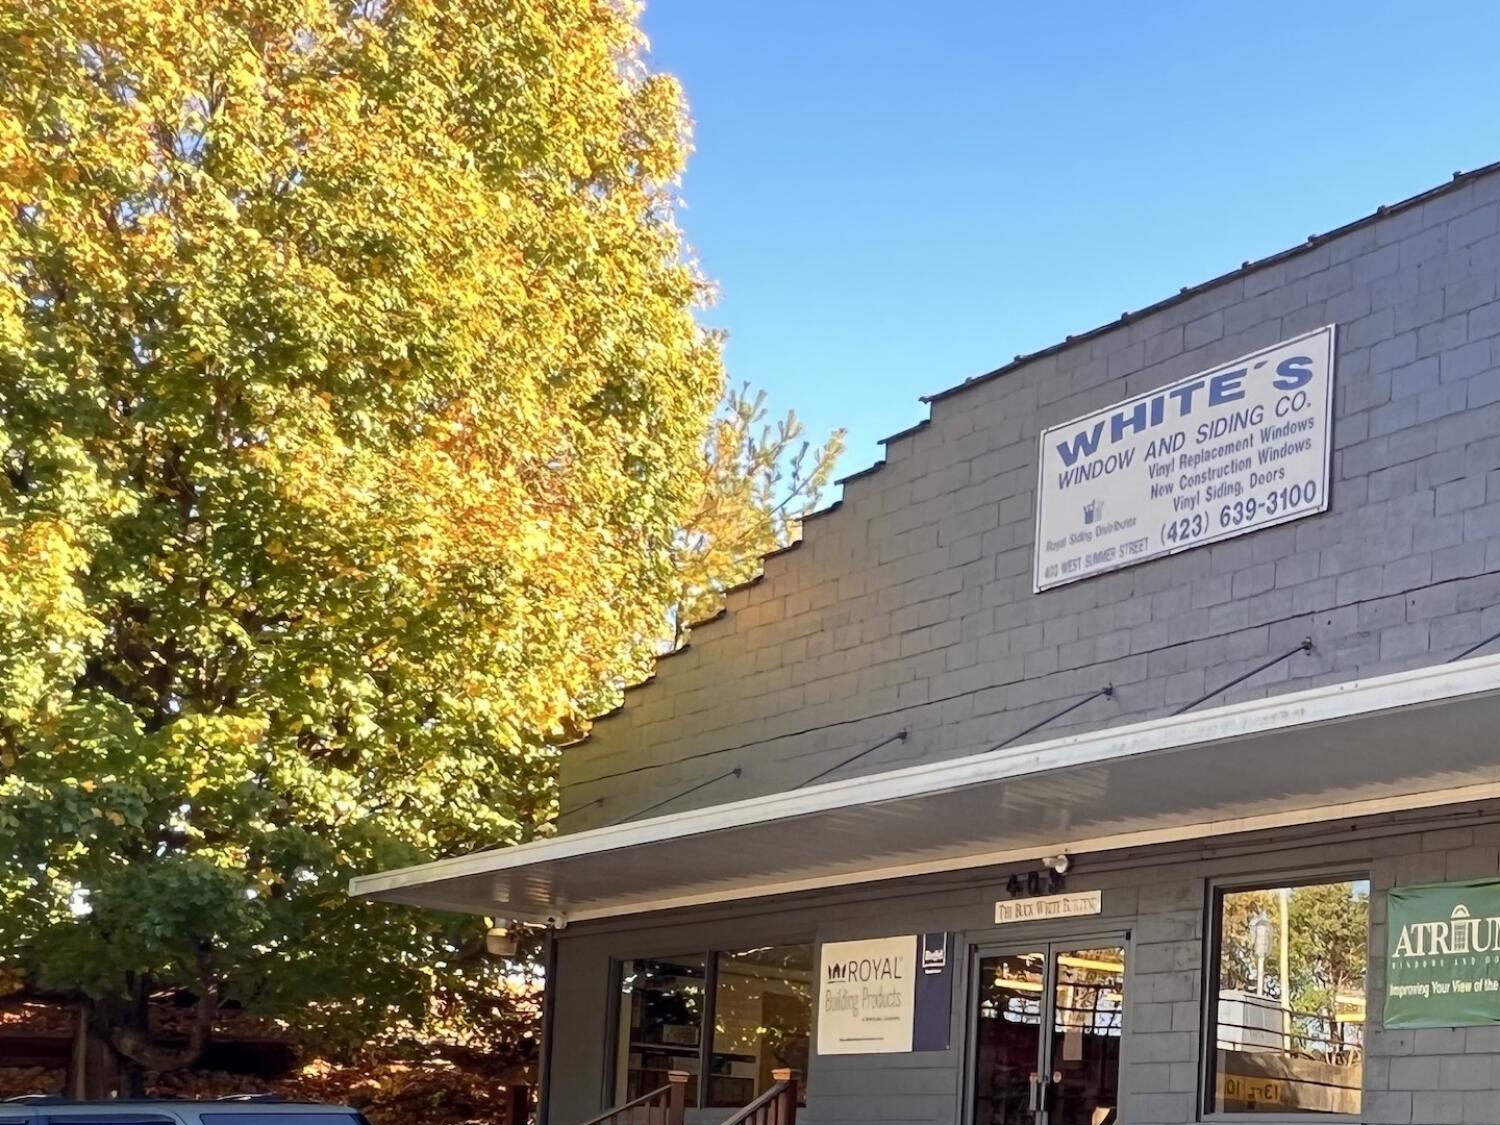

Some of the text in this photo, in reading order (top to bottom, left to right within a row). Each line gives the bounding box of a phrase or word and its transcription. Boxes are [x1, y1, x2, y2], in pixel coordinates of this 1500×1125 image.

[1058, 390, 1312, 490] WINDOW AND SIDING CO.
[1148, 417, 1315, 479] Vinyl Replacement Windows
[1150, 437, 1312, 500] New Construction Windows
[1173, 467, 1285, 513] Vinyl Siding, Doors
[1160, 479, 1317, 546] (423) 639-3100
[1061, 557, 1082, 574] WEST
[1119, 536, 1149, 558] STREET
[848, 956, 903, 982] ROYAL
[1389, 983, 1430, 998] Improving
[1431, 981, 1451, 994] Your
[1452, 979, 1474, 993] View
[1473, 978, 1484, 992] of
[1484, 978, 1499, 991] the
[825, 985, 902, 1018] Building Products
